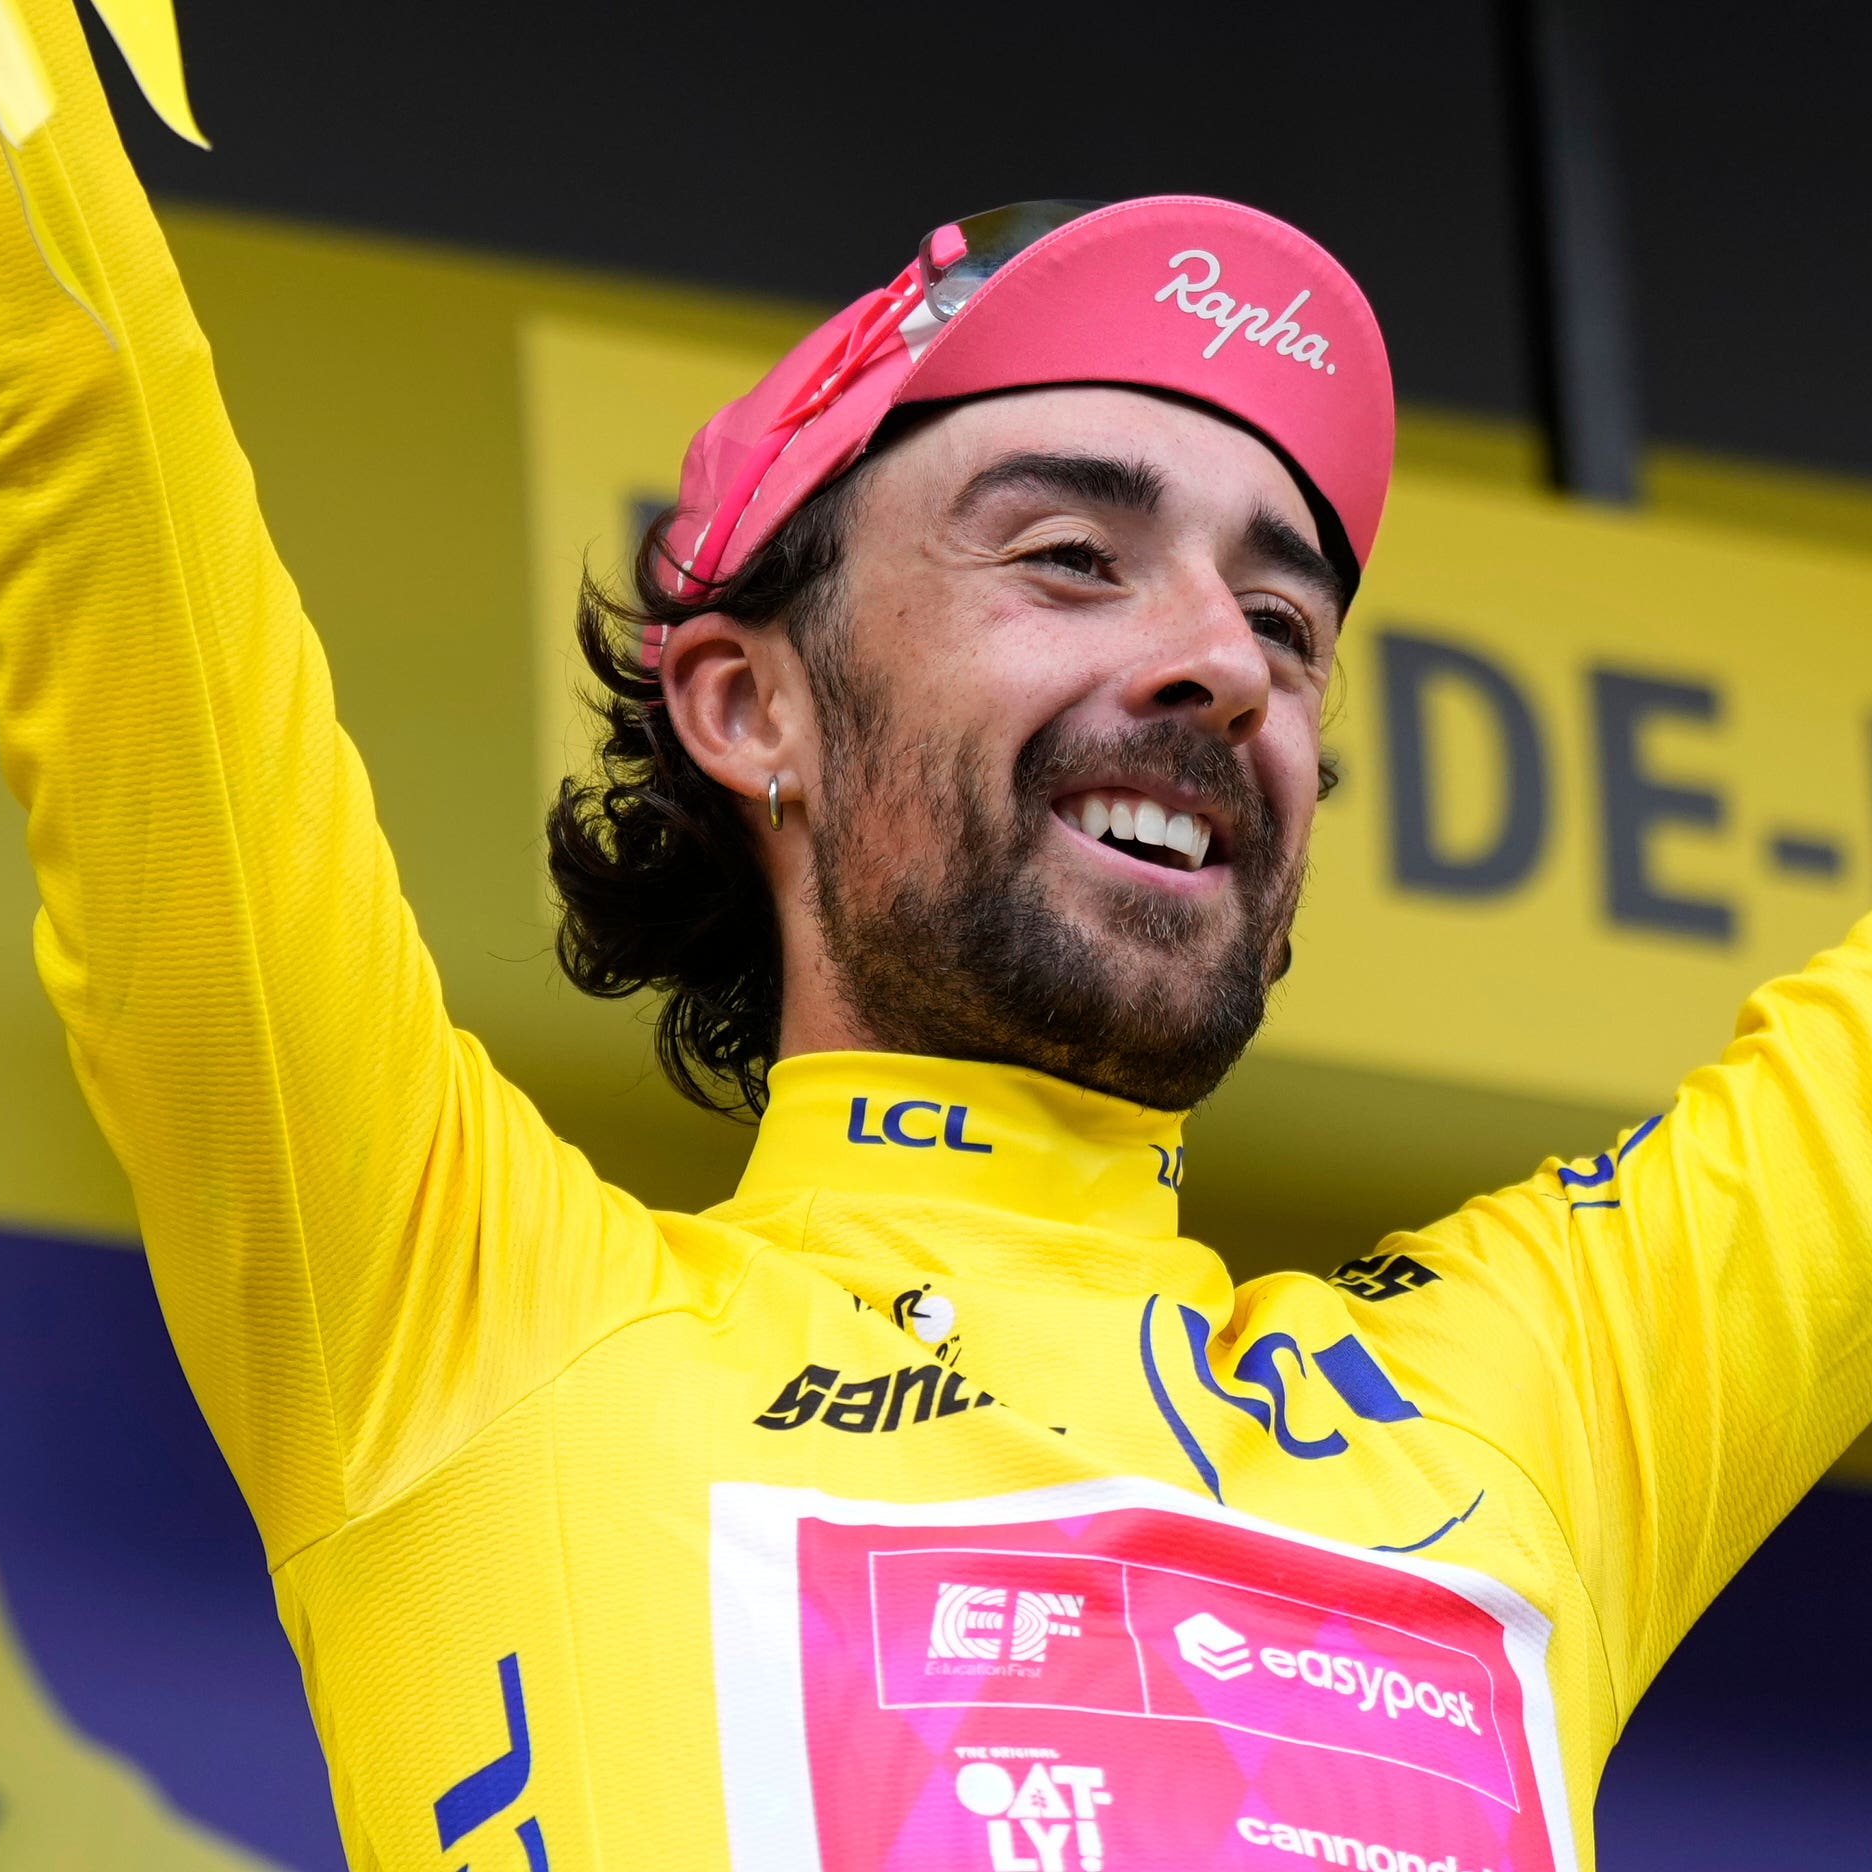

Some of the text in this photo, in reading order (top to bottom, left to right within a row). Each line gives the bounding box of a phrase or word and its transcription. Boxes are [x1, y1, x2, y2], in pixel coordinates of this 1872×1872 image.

[847, 1096, 993, 1154] LCL
[927, 1582, 1085, 1662] EF
[1260, 1647, 1481, 1735] easypost
[986, 1818, 1104, 1872] LY!
